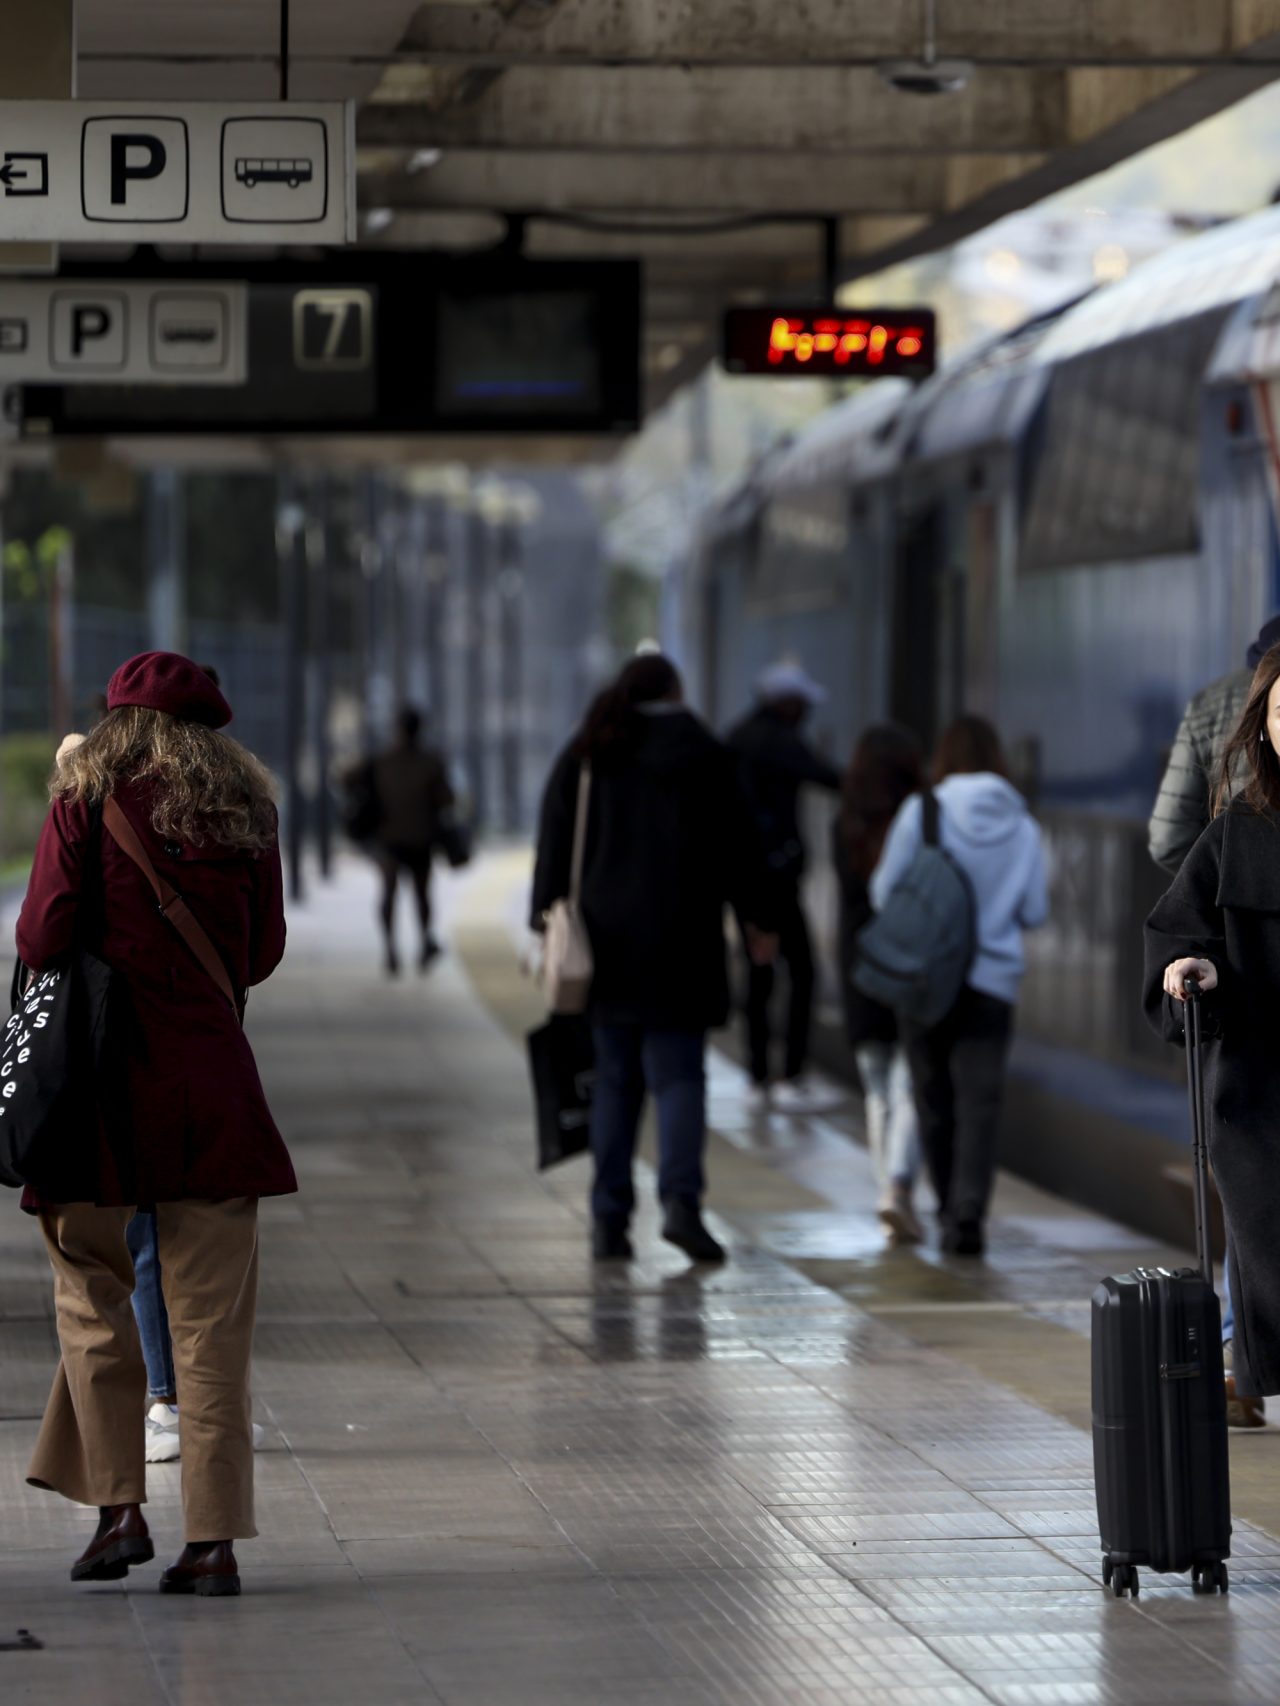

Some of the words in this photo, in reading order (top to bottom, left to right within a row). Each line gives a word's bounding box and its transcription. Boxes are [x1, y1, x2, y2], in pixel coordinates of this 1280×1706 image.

[110, 133, 166, 205] P
[70, 304, 112, 358] P
[316, 297, 349, 362] 7
